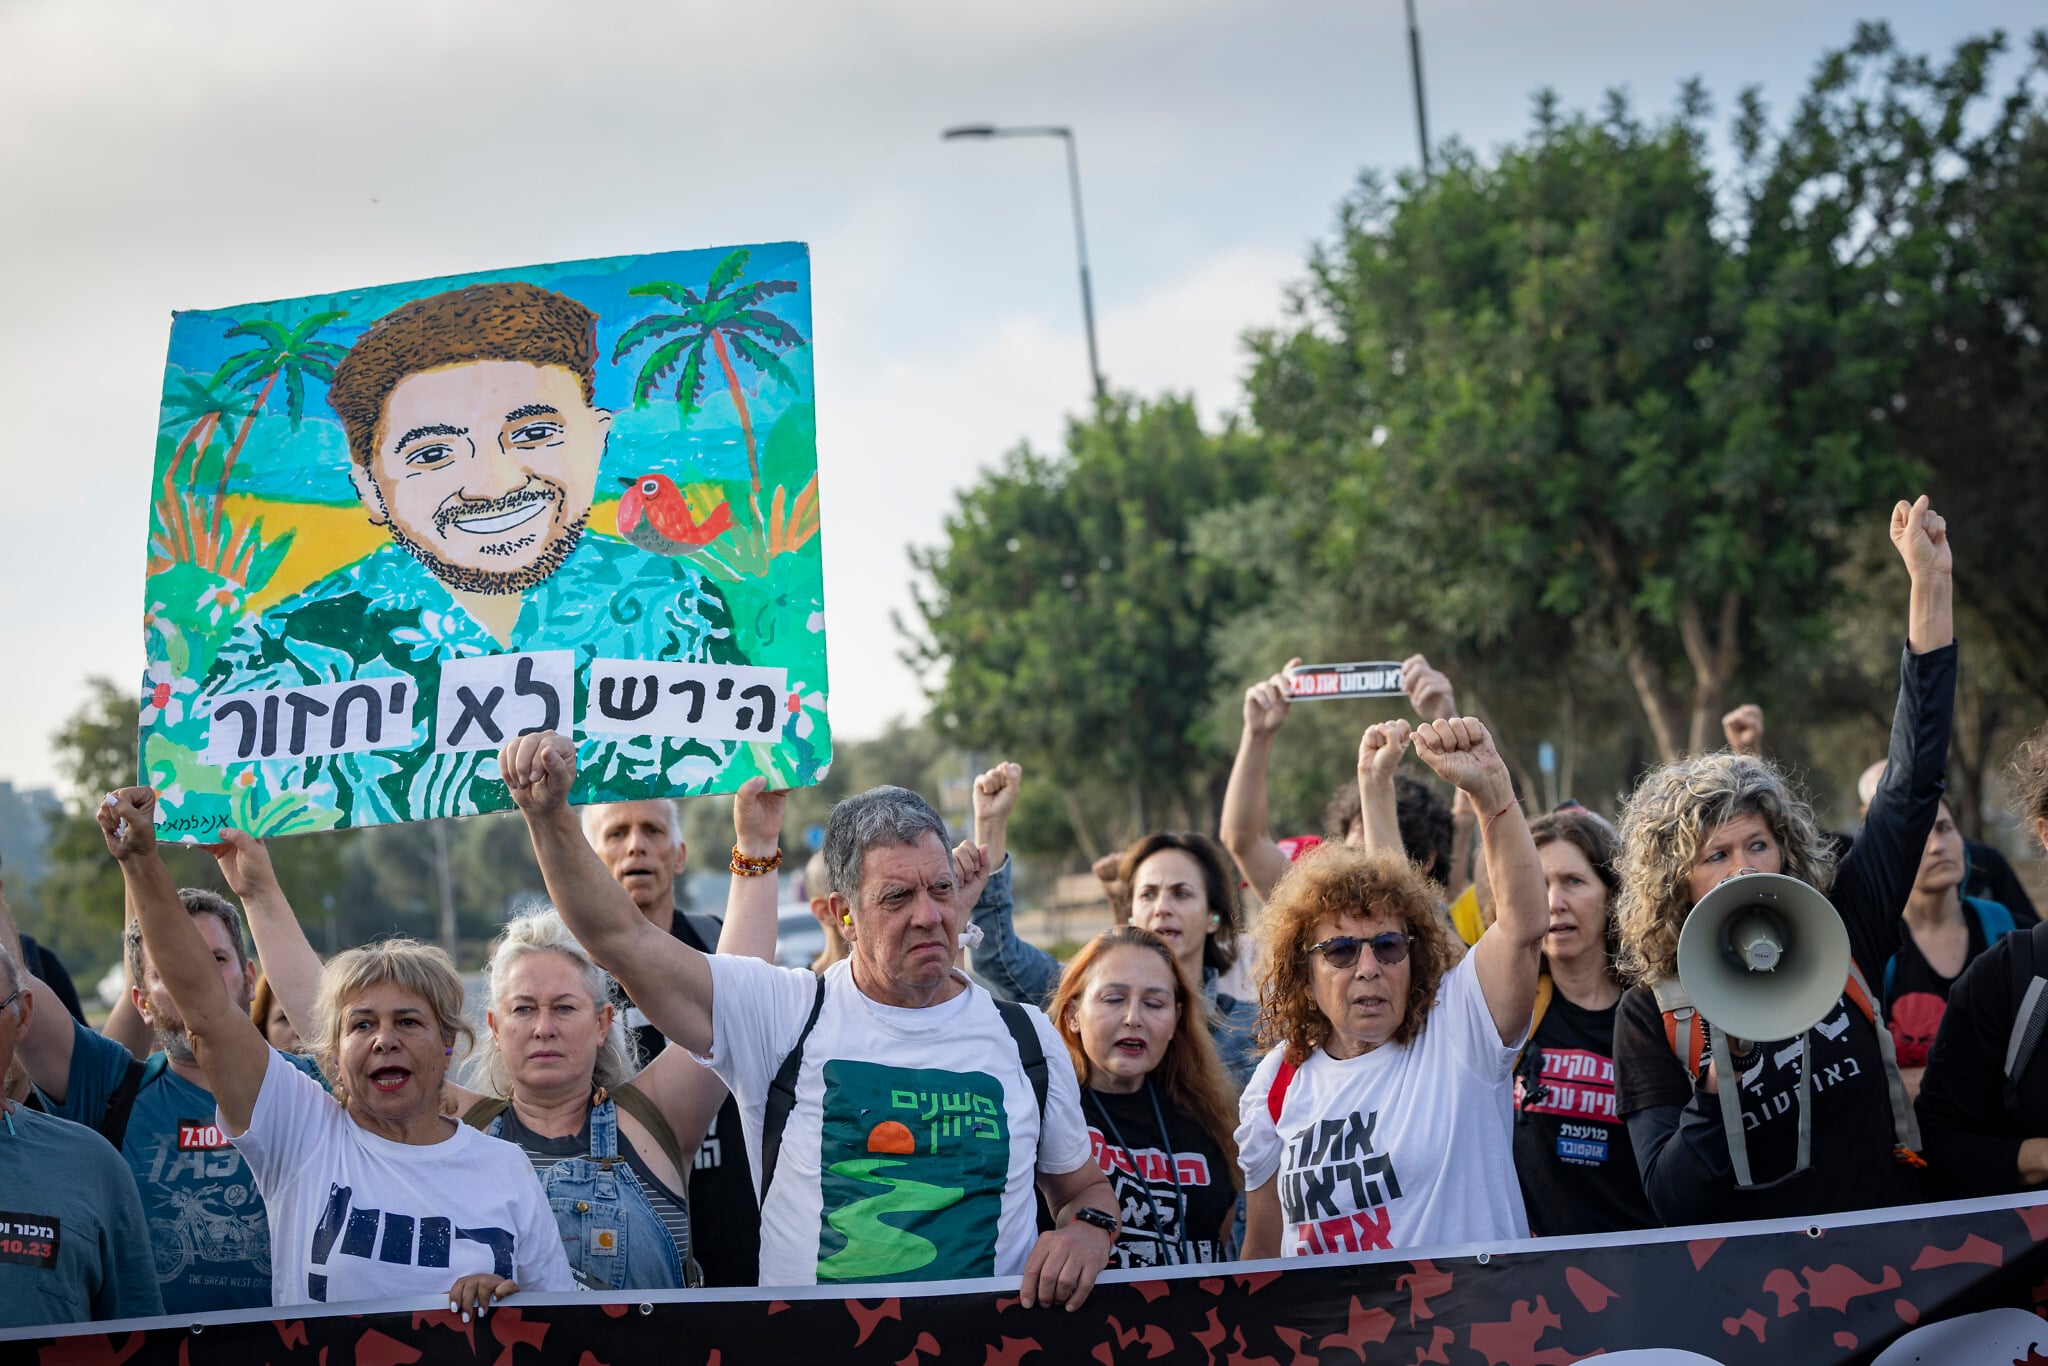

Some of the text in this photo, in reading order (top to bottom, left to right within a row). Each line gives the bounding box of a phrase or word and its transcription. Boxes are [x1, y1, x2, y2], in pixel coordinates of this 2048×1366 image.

[213, 656, 776, 758] הירש לא יחזור
[891, 1089, 998, 1121] משנים
[182, 1126, 217, 1147] 7.10
[930, 1114, 1000, 1155] כיוון
[1286, 1110, 1378, 1172] אתה
[1560, 1122, 1608, 1141] מועצת
[1560, 1141, 1605, 1158] אוקטובר
[1282, 1152, 1403, 1225] הראש
[13, 1223, 54, 1239] נזכור
[189, 1274, 202, 1285] THE
[204, 1275, 228, 1287] GREAT
[230, 1277, 252, 1288] WEST
